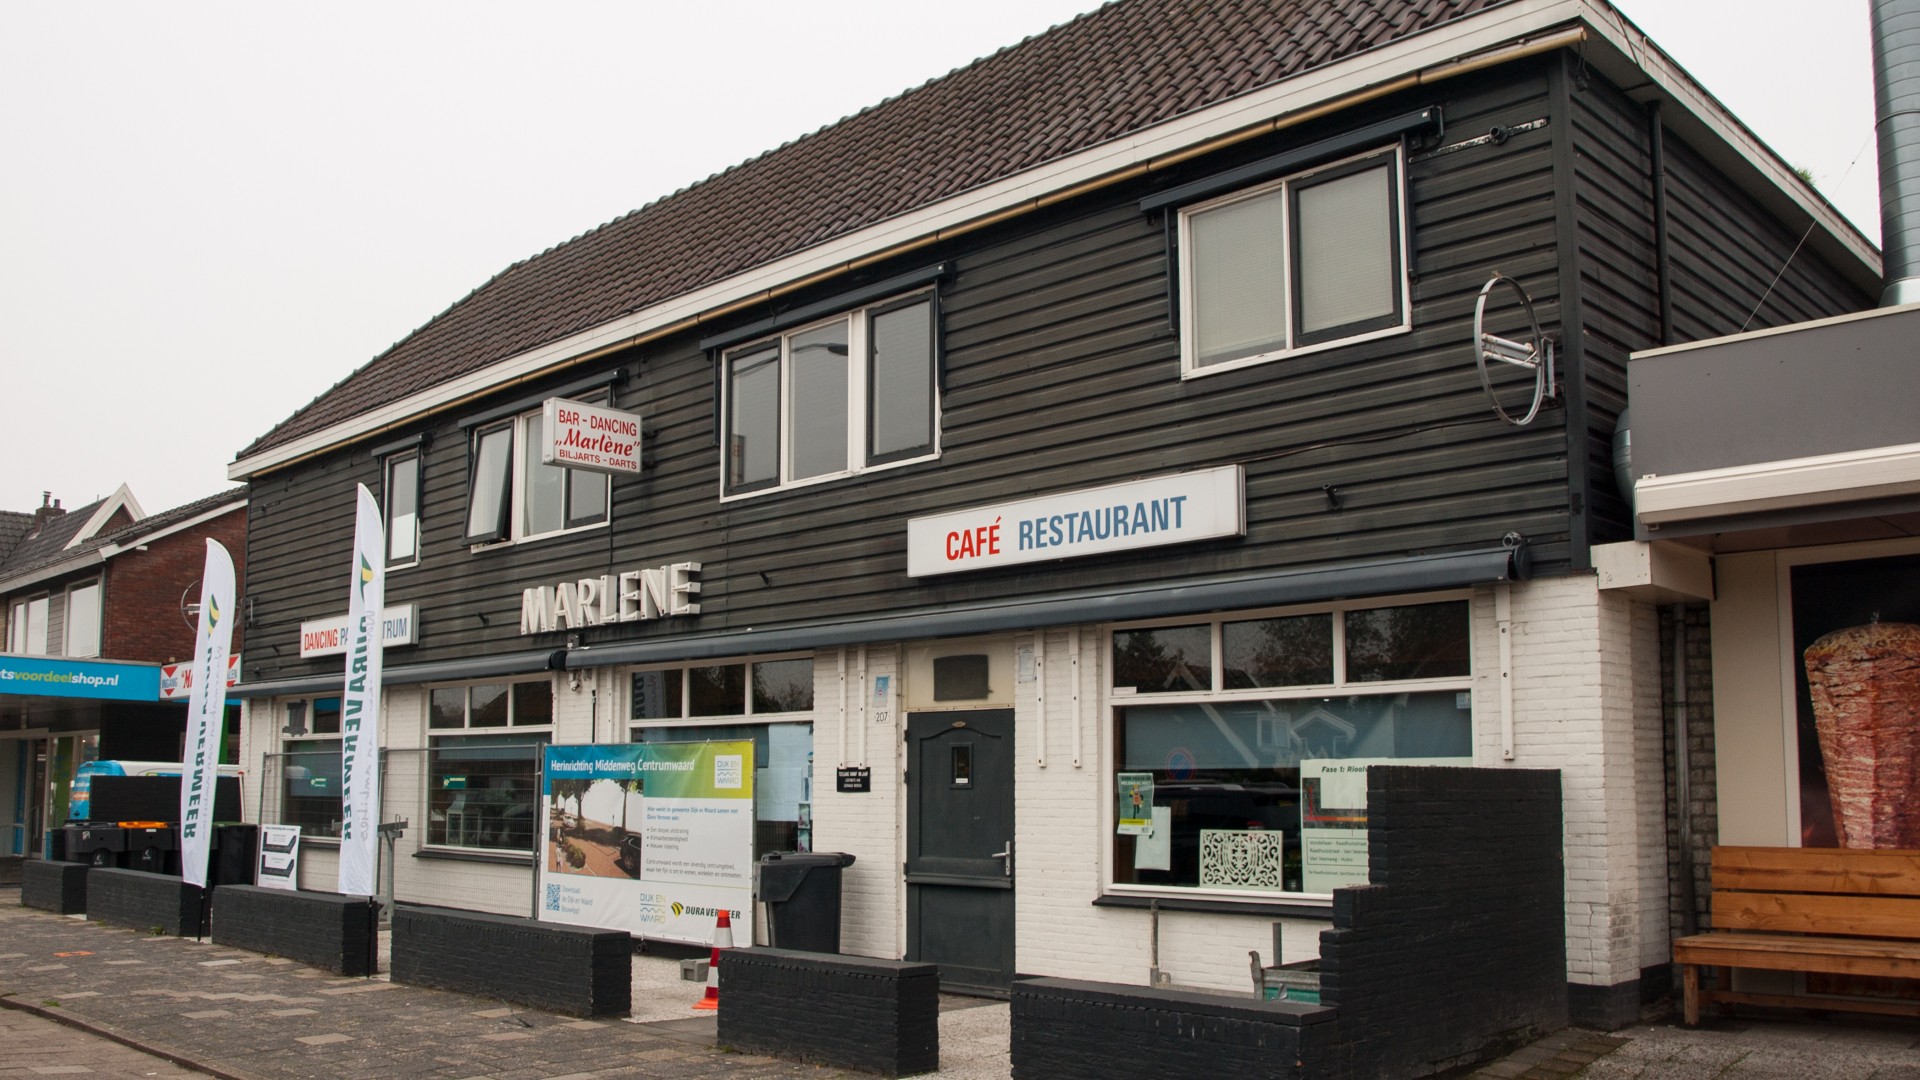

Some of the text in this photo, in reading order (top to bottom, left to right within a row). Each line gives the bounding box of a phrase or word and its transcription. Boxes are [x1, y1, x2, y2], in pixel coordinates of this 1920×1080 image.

[559, 409, 580, 426] BAR
[590, 415, 637, 437] DANCING
[559, 449, 601, 464] BILJARTS
[609, 458, 637, 470] DARTS
[946, 495, 1187, 561] CAFÉ RESTAURANT
[521, 561, 702, 635] MARLENE
[304, 618, 407, 651] DANCING PA TRUM
[0, 668, 119, 688] tsvoordeelshop.nl
[162, 677, 178, 689] INGANG
[876, 712, 888, 722] 207
[551, 758, 695, 774] Herinrichting Middenweg Centrumwaard
[640, 893, 666, 903] DIJK EN
[705, 908, 741, 919] VEREER
